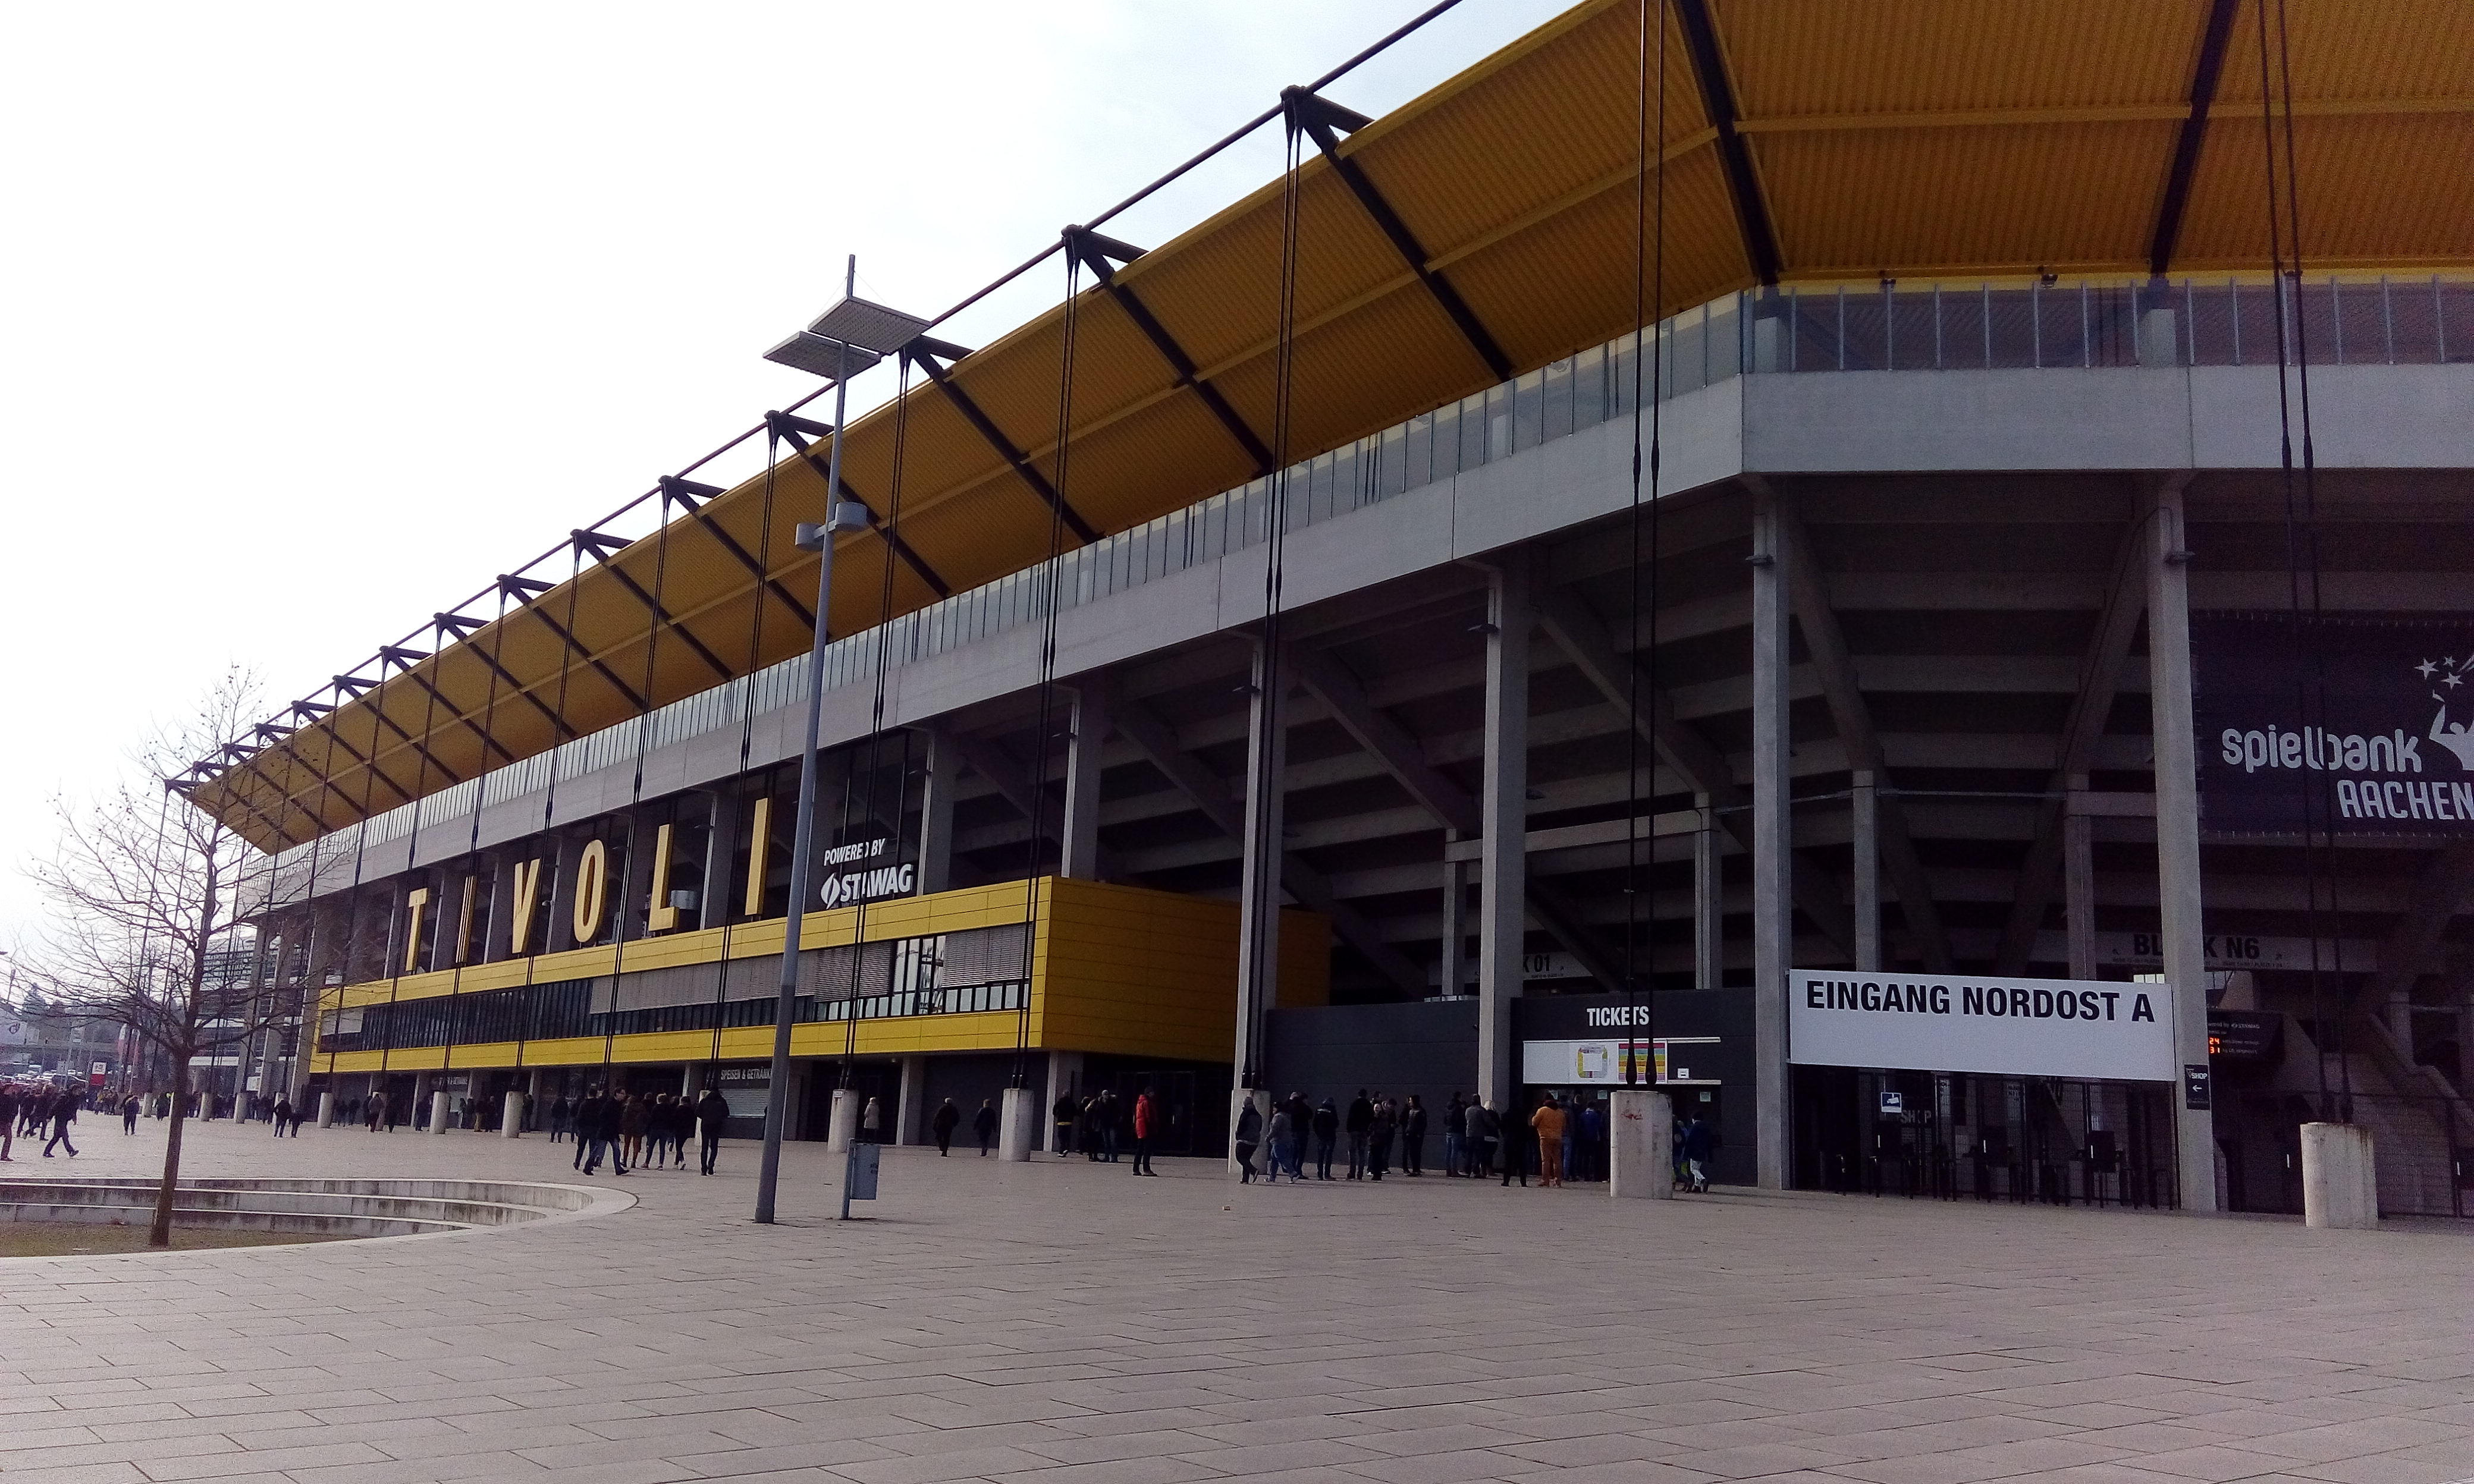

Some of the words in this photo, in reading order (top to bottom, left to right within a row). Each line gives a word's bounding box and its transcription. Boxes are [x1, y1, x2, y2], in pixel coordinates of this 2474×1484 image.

[2222, 724, 2422, 773] spielbank
[2337, 779, 2474, 820] AACHEN
[824, 842, 869, 866] POWERED
[871, 838, 886, 857] BY
[406, 797, 770, 971] TIVOLI
[840, 863, 913, 903] STAWAG
[2226, 936, 2259, 959] N6
[1586, 1005, 1650, 1026] TICKETS
[1806, 980, 1951, 1014] EINGANG
[1962, 986, 2120, 1021] NORDOST
[2131, 993, 2156, 1023] A
[720, 1070, 740, 1080] SPEISEN
[747, 1066, 771, 1080] GETRÄNK
